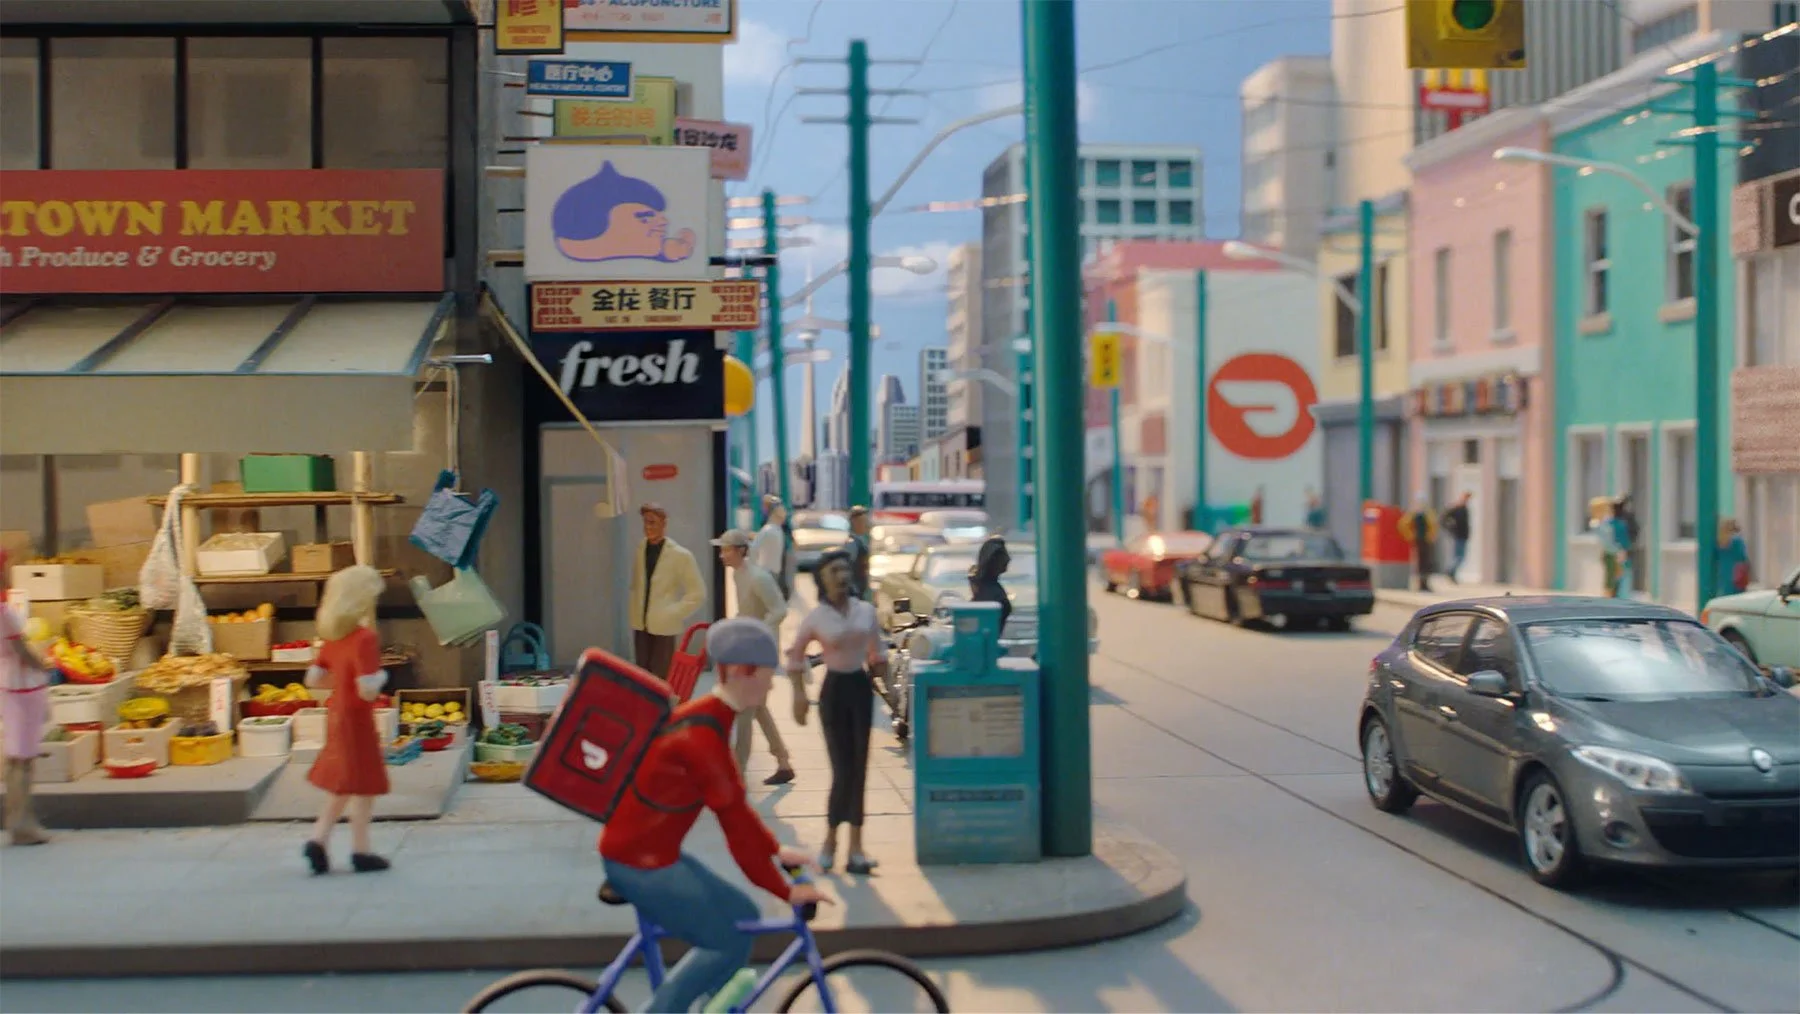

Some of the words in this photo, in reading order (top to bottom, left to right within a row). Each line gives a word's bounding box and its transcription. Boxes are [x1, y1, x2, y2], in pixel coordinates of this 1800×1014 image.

[0, 199, 167, 237] TOWN
[179, 200, 416, 237] MARKET
[18, 245, 129, 268] Produce
[137, 245, 164, 268] &
[170, 245, 277, 271] Grocery
[559, 338, 700, 398] fresh
